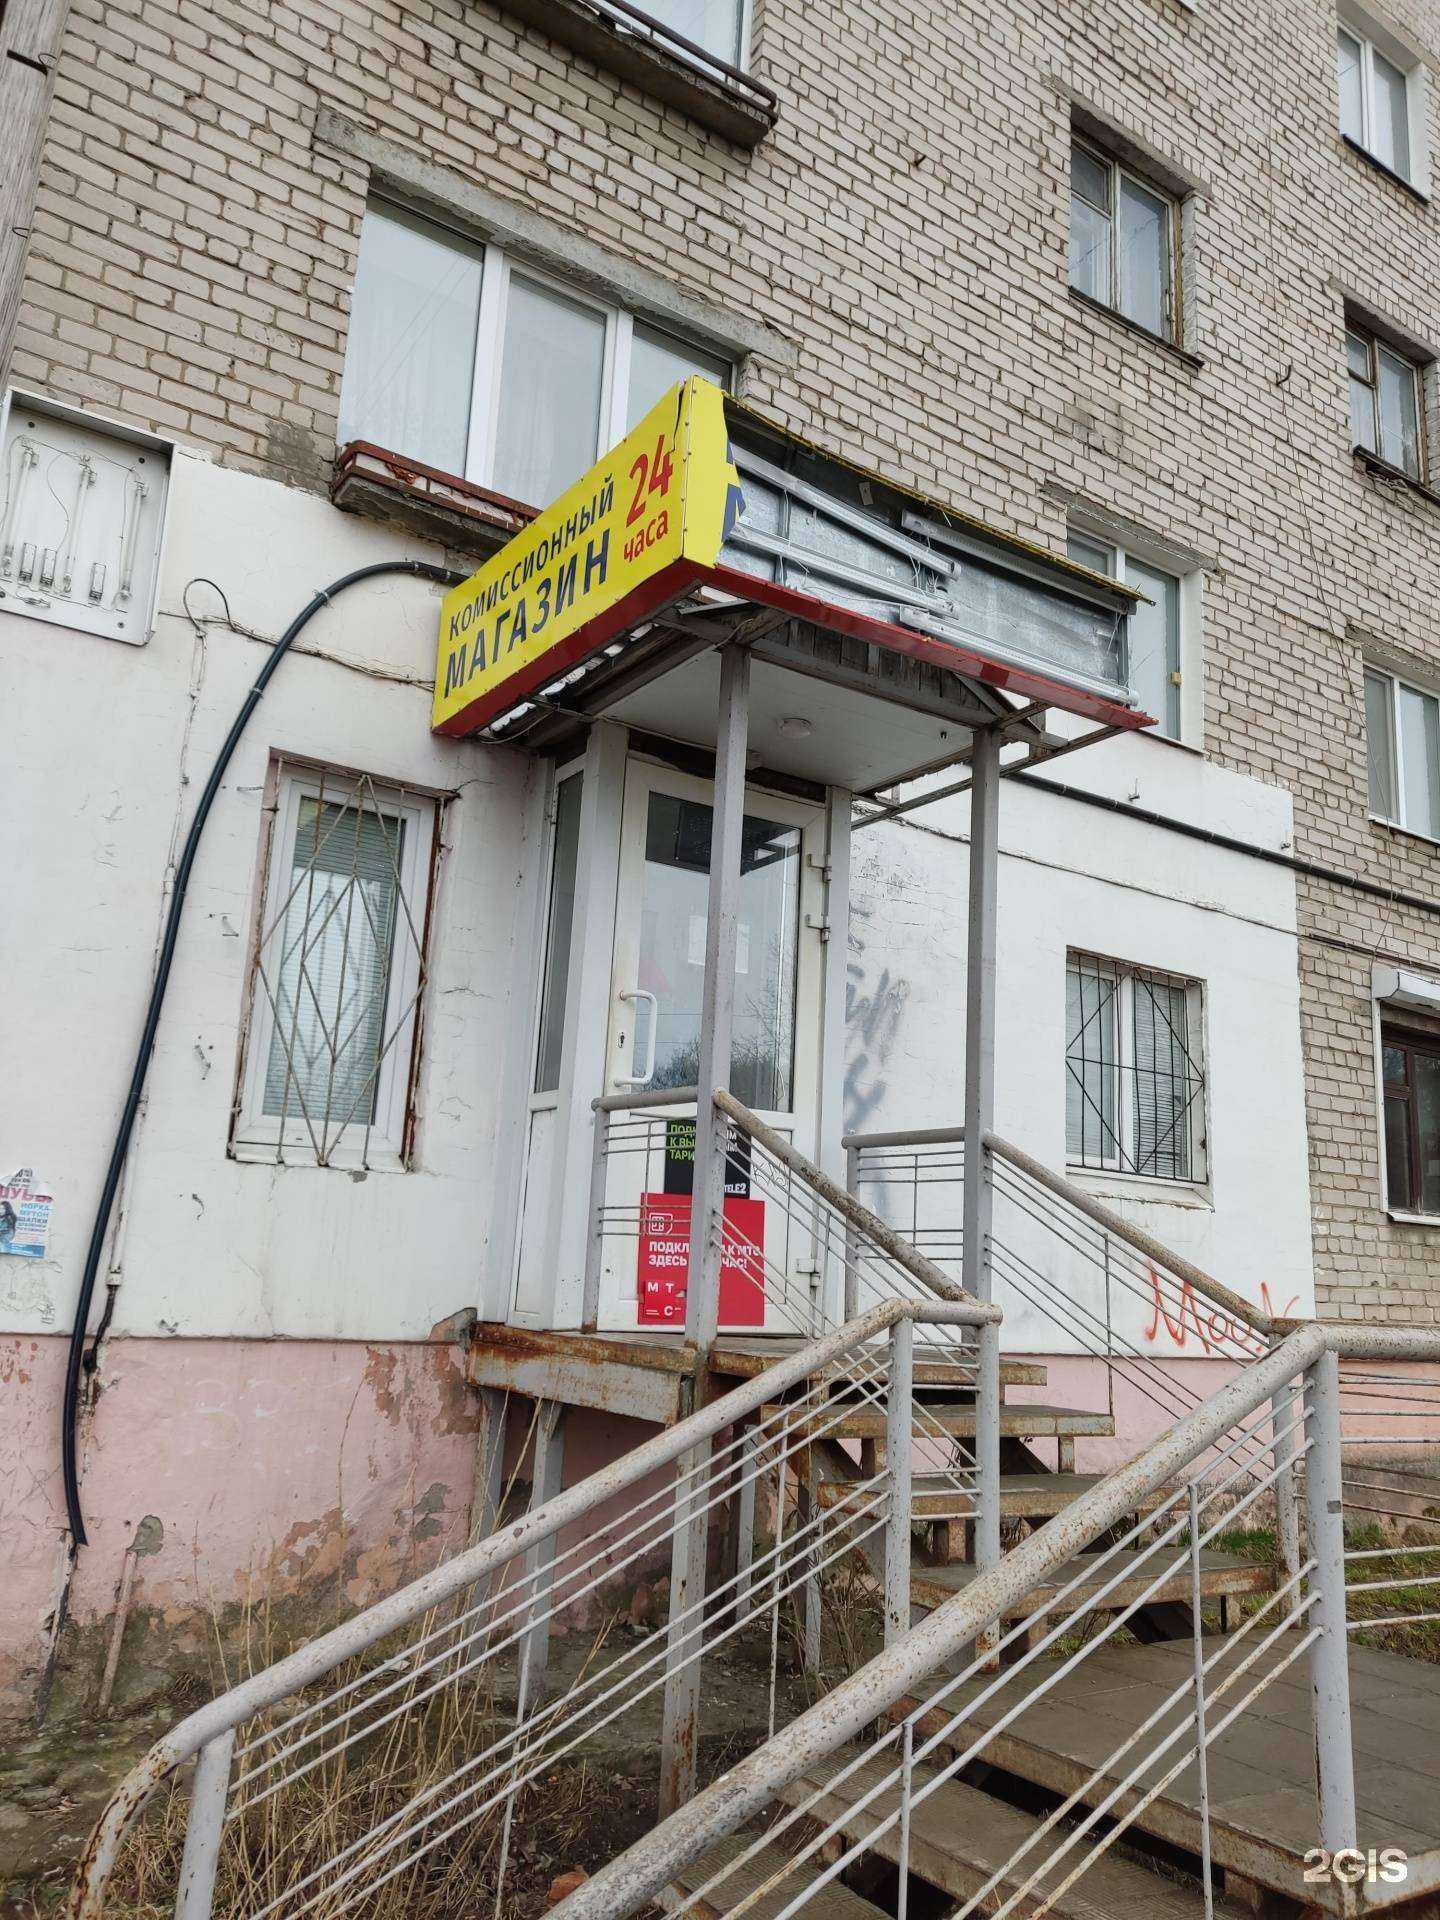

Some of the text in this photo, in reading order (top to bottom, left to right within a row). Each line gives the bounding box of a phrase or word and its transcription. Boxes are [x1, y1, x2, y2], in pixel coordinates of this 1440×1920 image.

[626, 434, 674, 528] 24
[449, 473, 614, 641] КОМИССИОННЫЙ
[623, 509, 669, 563] часа
[444, 528, 610, 698] МАГАЗИН
[670, 1150, 696, 1160] ТАРИ
[649, 1254, 688, 1267] ЗДЕСЬ
